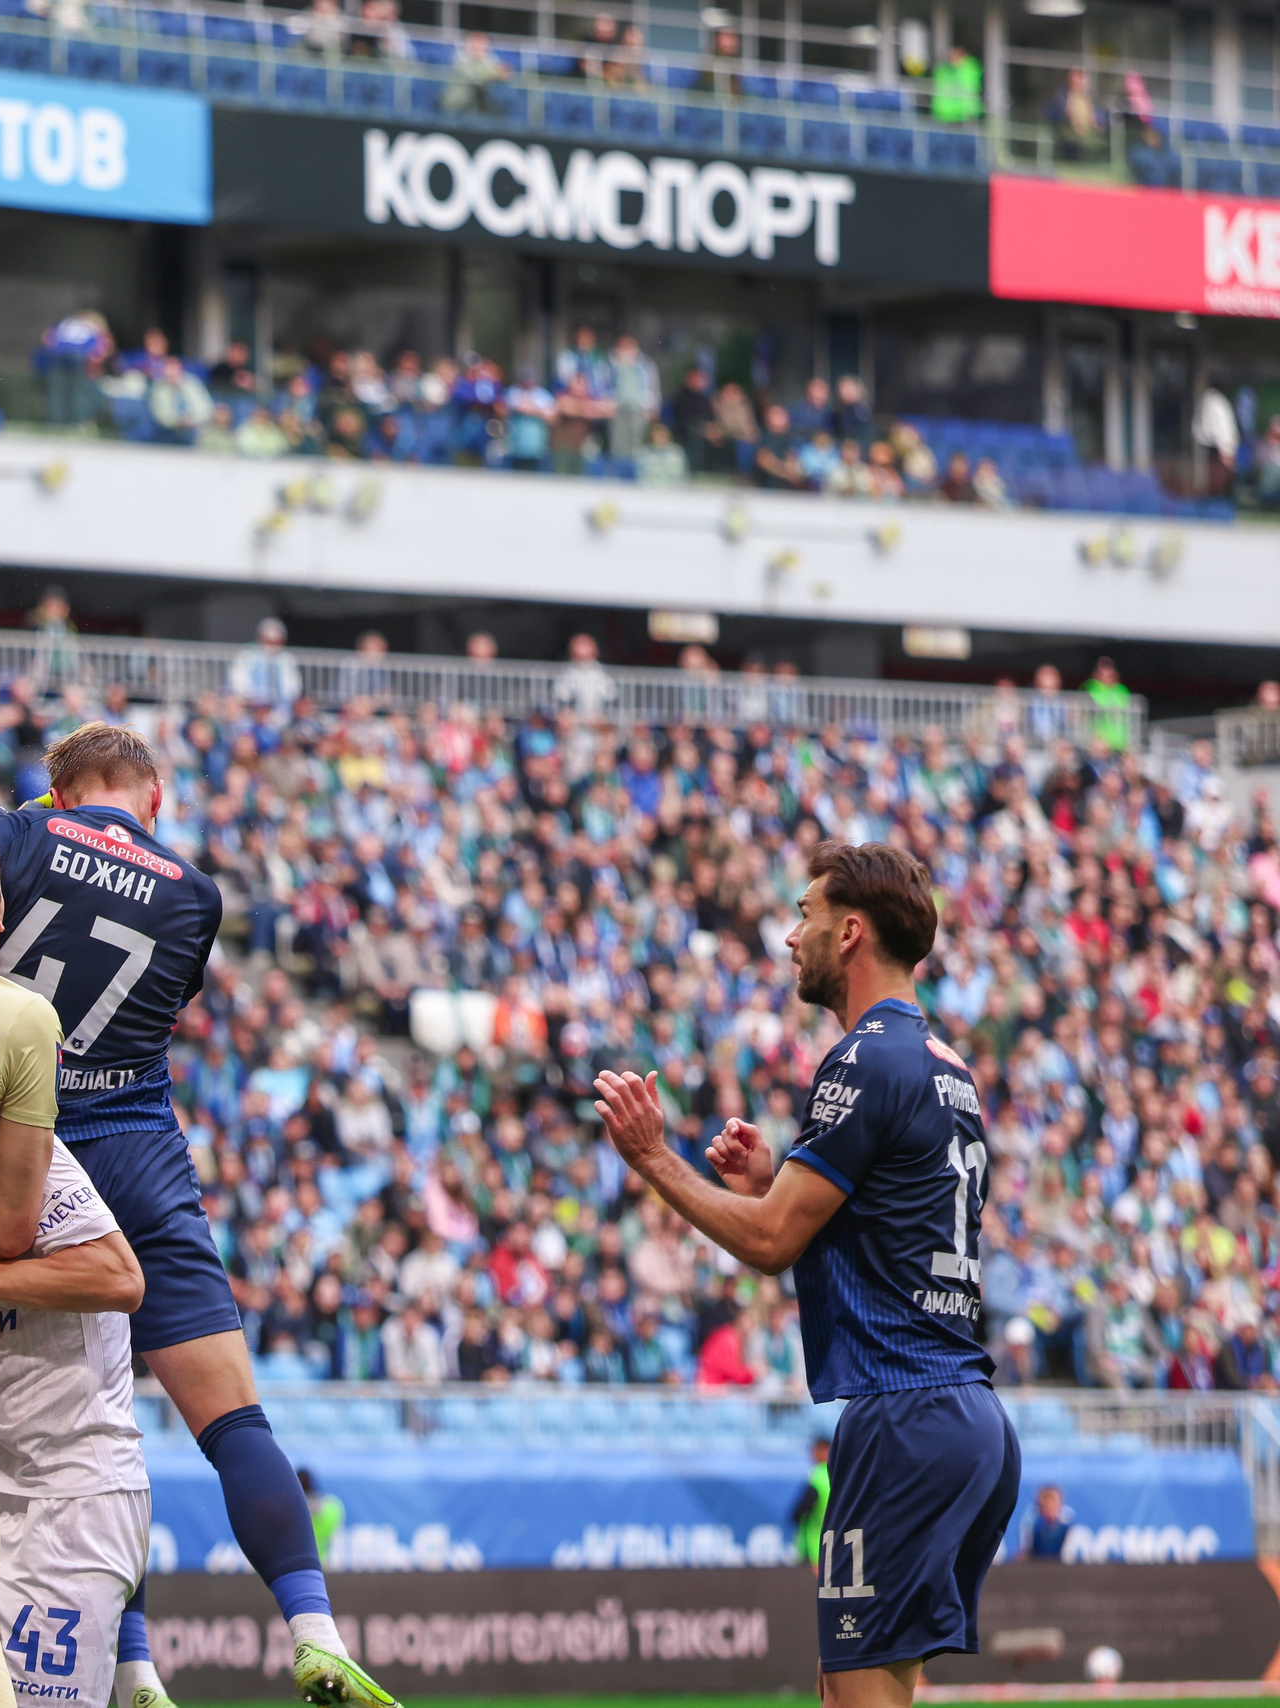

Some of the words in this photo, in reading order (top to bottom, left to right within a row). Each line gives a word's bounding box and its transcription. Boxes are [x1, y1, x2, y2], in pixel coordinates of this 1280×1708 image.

[49, 843, 157, 905] БОЖИН
[55, 824, 175, 878] СОЛИДАРНОСТЬ
[143, 851, 171, 868] БАНК
[810, 1100, 854, 1126] BET
[813, 1081, 862, 1107] FON
[37, 1186, 98, 1235] MEVER
[818, 1528, 876, 1599] 11
[5, 1604, 81, 1677] 43
[364, 1595, 630, 1678] водителей
[631, 1606, 769, 1662] такси
[835, 1631, 863, 1640] KELME
